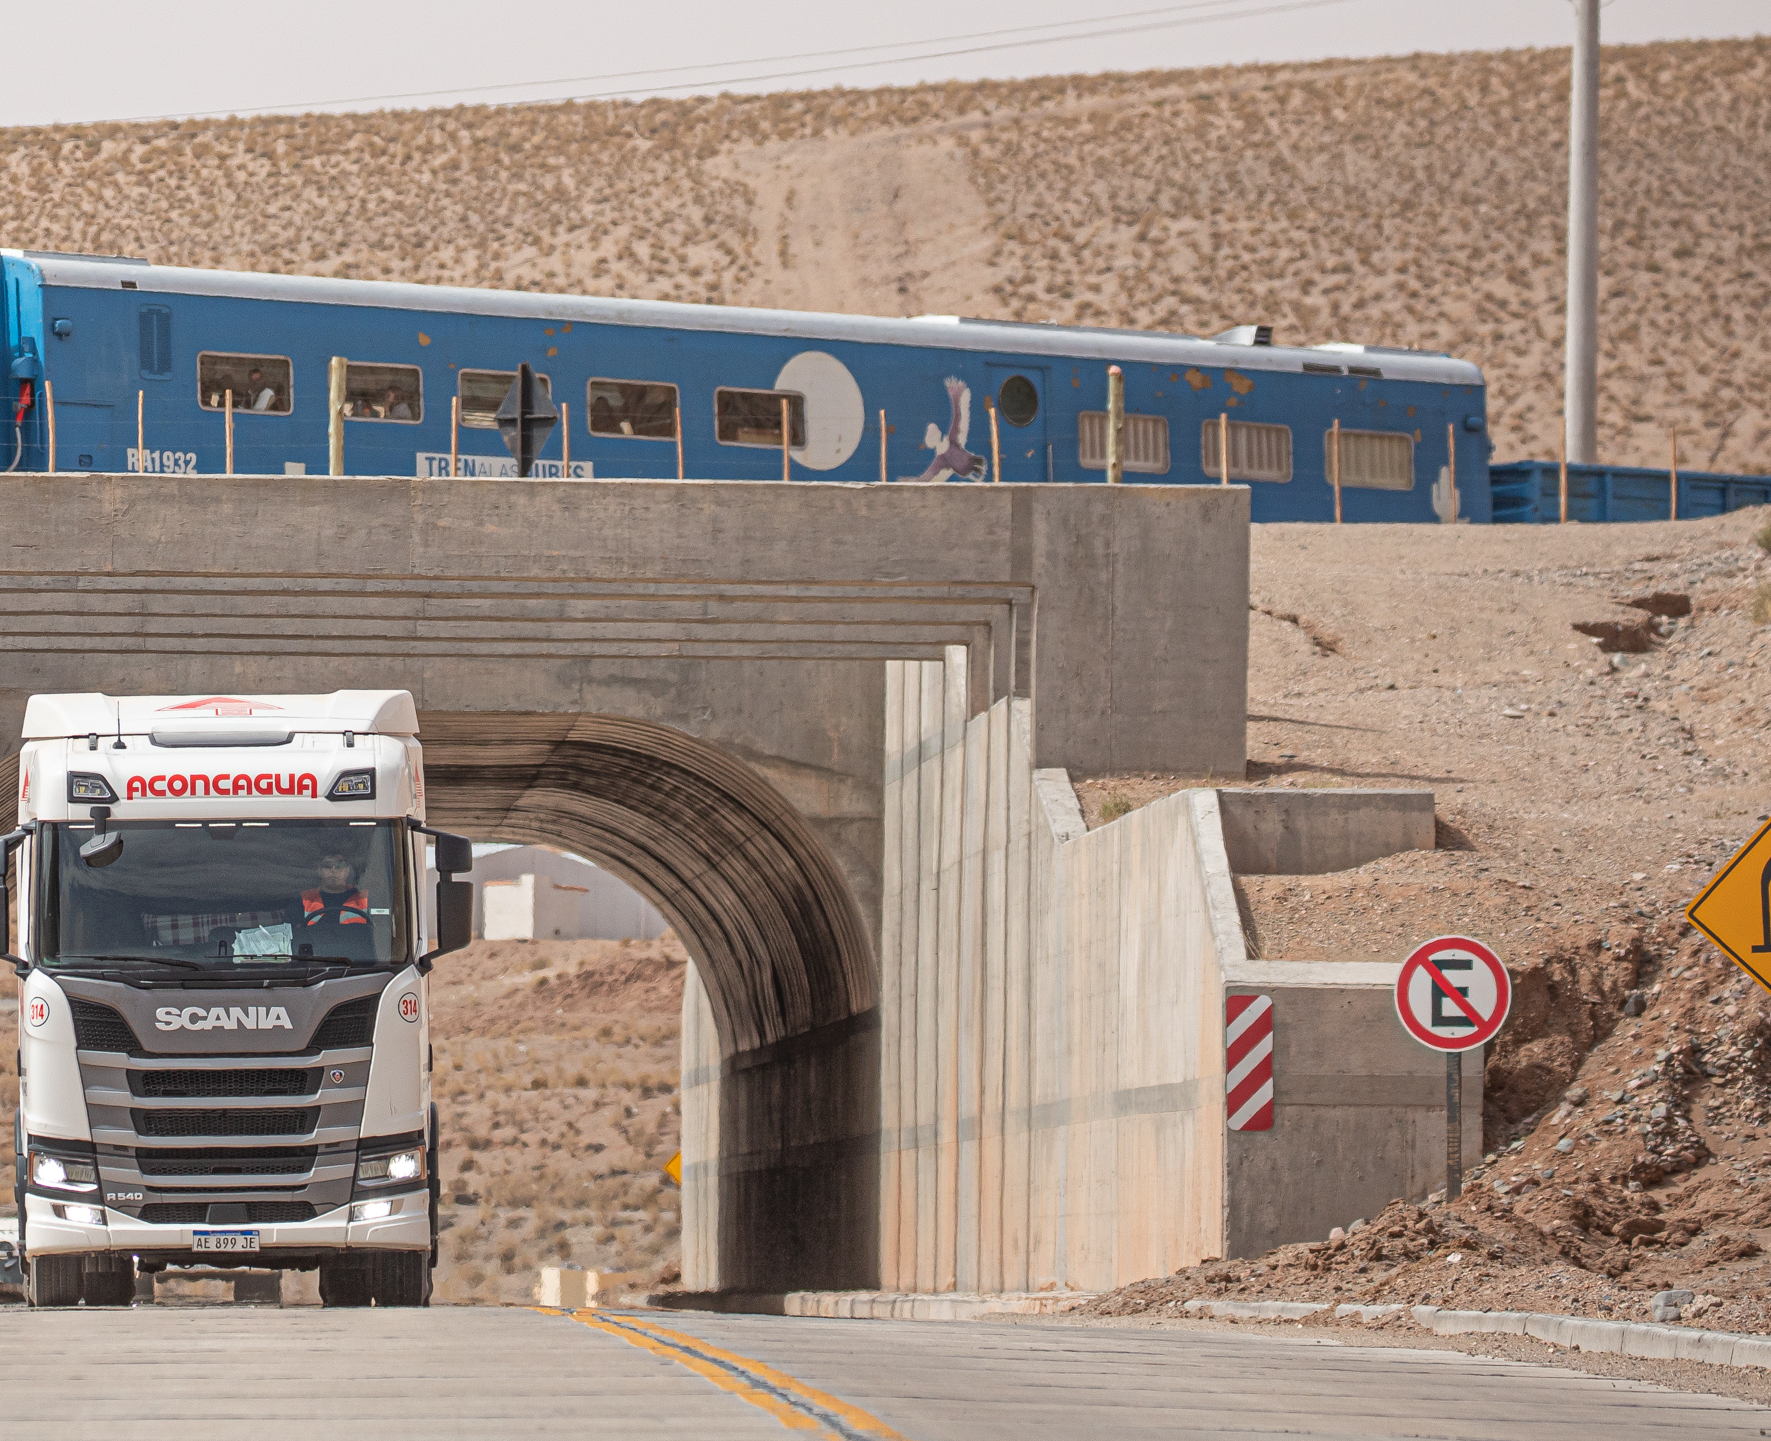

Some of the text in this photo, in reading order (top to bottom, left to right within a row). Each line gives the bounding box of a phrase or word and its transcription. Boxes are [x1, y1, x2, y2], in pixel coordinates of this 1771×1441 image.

[126, 447, 198, 475] RA1932
[126, 772, 318, 801] ACONCAGUA
[1431, 959, 1476, 1028] E
[30, 1003, 45, 1021] 314
[402, 999, 418, 1016] 314
[154, 1006, 294, 1031] SCANIA
[106, 1192, 144, 1201] R 540
[196, 1237, 256, 1249] AE 899 JE
